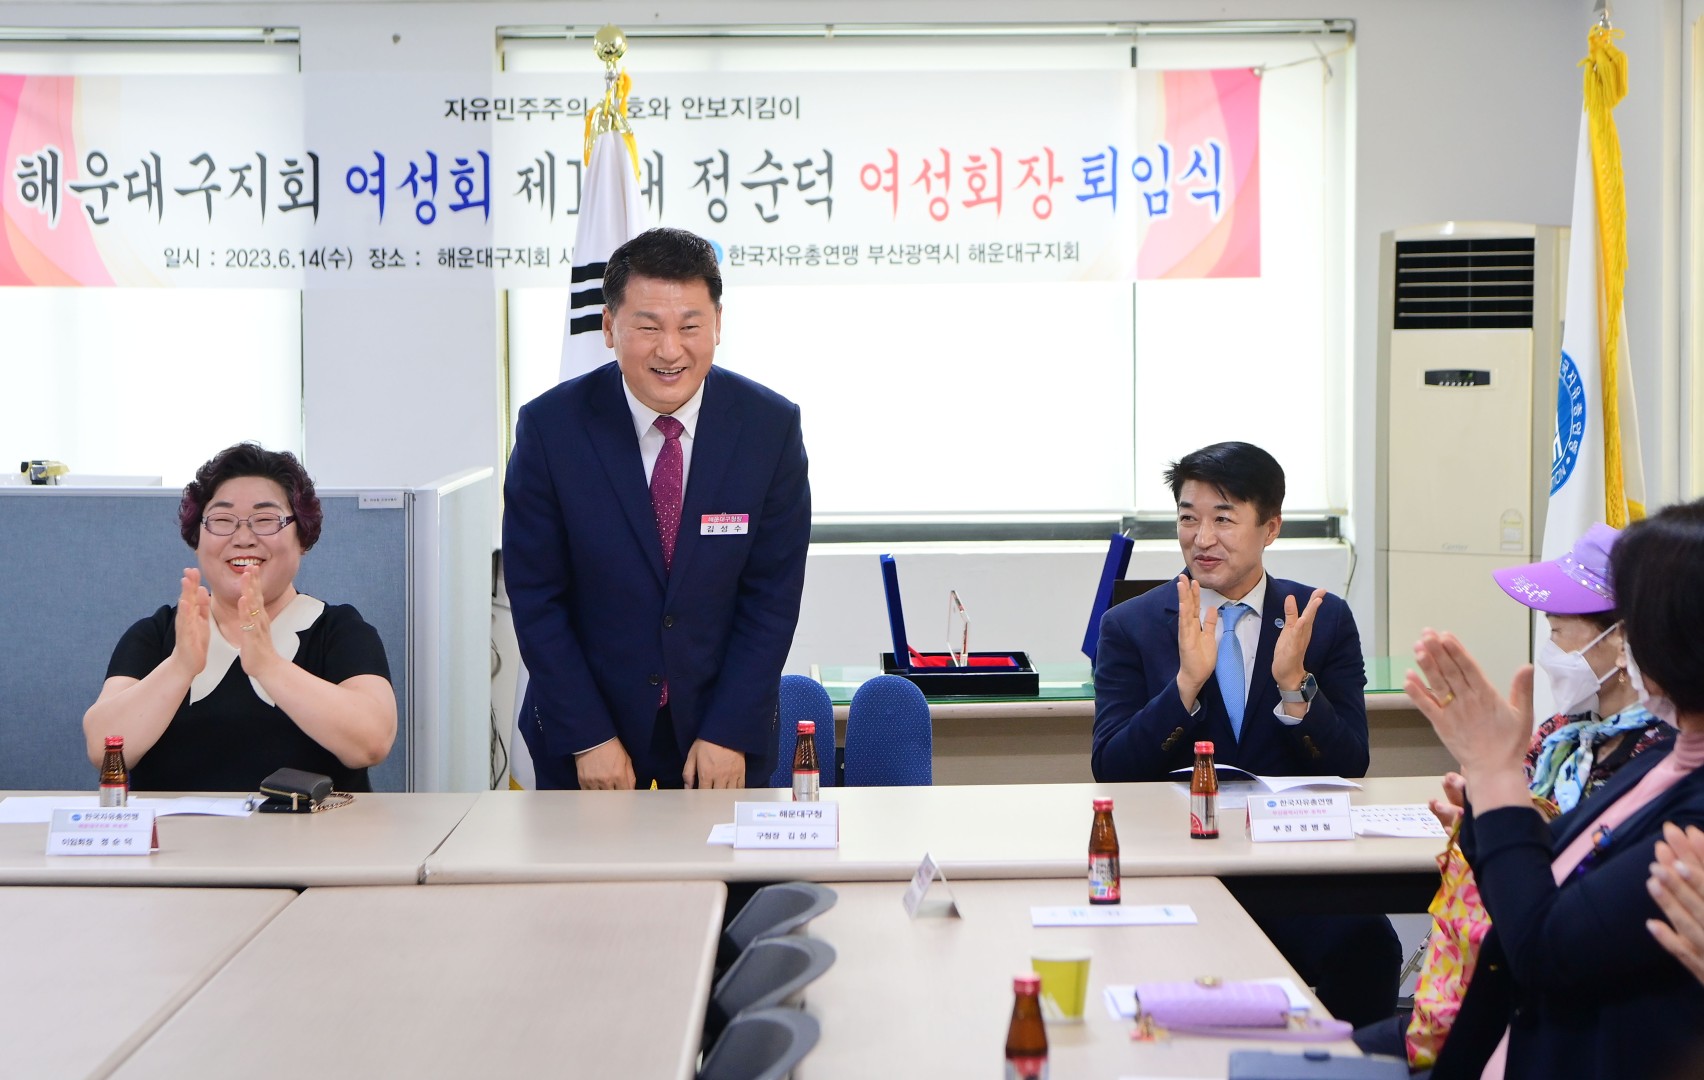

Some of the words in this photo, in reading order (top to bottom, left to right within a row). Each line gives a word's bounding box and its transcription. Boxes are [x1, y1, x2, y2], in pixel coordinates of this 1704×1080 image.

[445, 97, 588, 121] 자유민주주의
[627, 97, 671, 120] 호와
[682, 96, 800, 120] 안보지킴이
[17, 149, 320, 225] 해운대구지회
[346, 150, 491, 225] 여성회
[692, 149, 834, 223] 정순덕
[860, 146, 1064, 221] 여성회장
[1076, 143, 1222, 217] 퇴임식
[164, 247, 200, 269] 일시
[225, 246, 353, 271] 2023.6.14(수)
[369, 247, 406, 269] 장소
[437, 247, 550, 269] 해운대구지회
[728, 244, 859, 267] 한국자유총연맹
[867, 243, 959, 265] 부산광역시
[968, 241, 1079, 263] 해운대구지회
[779, 809, 823, 819] 해운대구청
